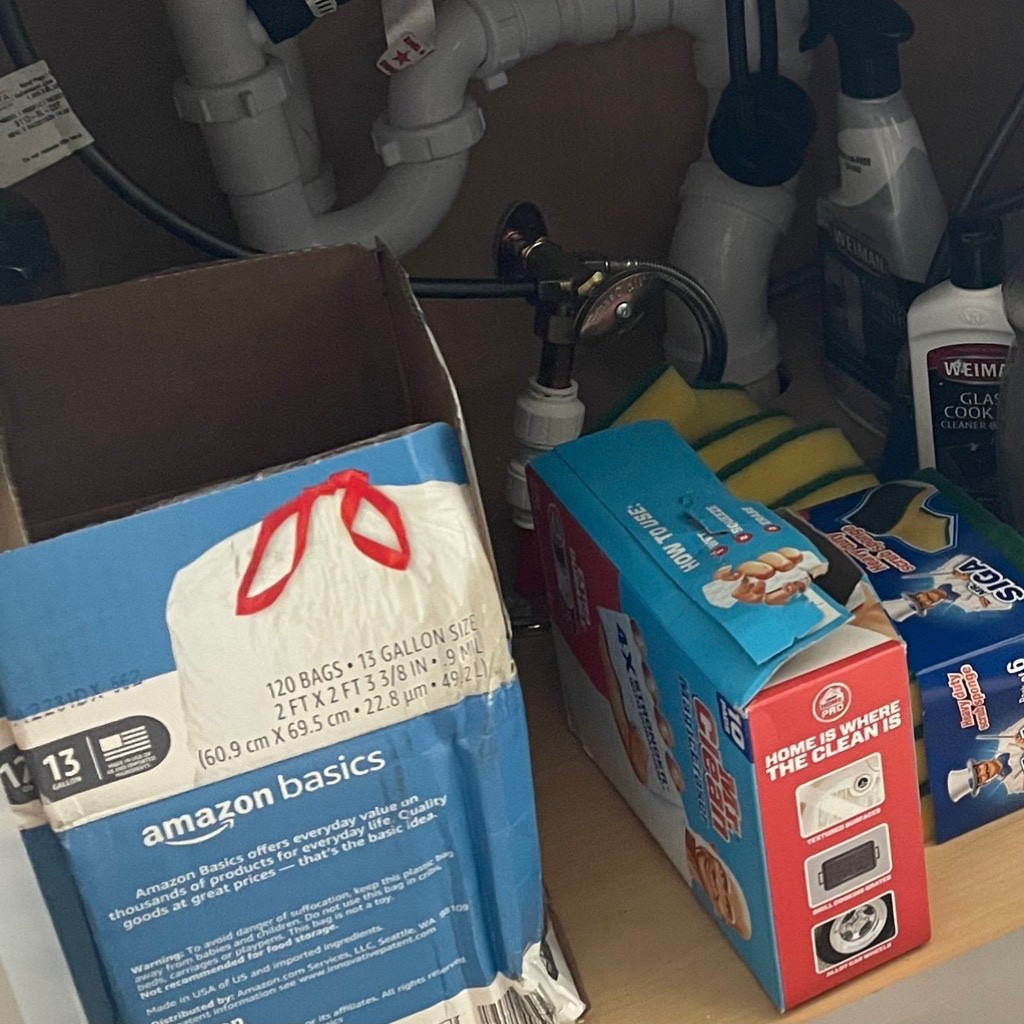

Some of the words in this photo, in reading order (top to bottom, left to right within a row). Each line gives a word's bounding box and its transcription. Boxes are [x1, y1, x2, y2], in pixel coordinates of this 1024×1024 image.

[944, 406, 993, 419] COOK
[627, 502, 659, 528] USE:
[649, 526, 673, 545] TO
[663, 542, 700, 573] HOW
[266, 676, 296, 699] 120
[299, 660, 344, 690] BAGS
[357, 651, 377, 670] 13
[380, 628, 446, 663] GALLON
[448, 614, 479, 642] SIZE
[617, 623, 637, 678] 4X
[274, 703, 289, 721] 2
[289, 694, 310, 717] FT
[313, 689, 326, 709] X
[326, 686, 340, 704] 2
[341, 679, 364, 701] FT
[366, 676, 377, 692] 3
[380, 663, 408, 687] 3/8
[410, 657, 429, 676] IN
[821, 703, 844, 718] PRO
[947, 673, 967, 700] duty
[957, 700, 975, 729] Heavy
[960, 664, 985, 706] sponge
[197, 740, 241, 770] (60.9
[245, 734, 271, 754] cm
[271, 726, 286, 745] X
[286, 714, 324, 740] 69.5
[326, 707, 351, 728] cm
[364, 690, 401, 716] 22.8
[765, 736, 817, 768] HOME
[819, 728, 836, 741] IS
[840, 700, 901, 736] WHERE
[765, 753, 808, 781] THE
[811, 725, 878, 763] CLEAN
[883, 713, 901, 733] IS
[42, 747, 81, 781] 13
[694, 696, 731, 843] Clean
[140, 786, 275, 847] amazon
[278, 749, 386, 800] basics
[108, 887, 188, 921] thousands
[190, 878, 206, 892] of
[209, 857, 275, 889] products
[277, 848, 297, 862] for
[301, 826, 365, 854] everyday
[398, 795, 447, 820] Quality
[135, 870, 196, 899] Amazon
[199, 853, 245, 876] Basics
[247, 838, 290, 860] offers
[293, 816, 357, 844] everyday
[360, 802, 397, 821] value
[401, 795, 419, 807] on
[123, 906, 169, 931] goods
[172, 899, 188, 912] at
[190, 884, 231, 907] great
[232, 867, 277, 892] prices
[341, 838, 366, 852] the
[367, 826, 403, 844] basic
[130, 951, 185, 974] Warning:
[185, 945, 201, 954] To
[203, 931, 233, 949] avoid
[235, 919, 274, 938] danger
[275, 912, 288, 923] of
[140, 986, 163, 1000] Not
[164, 955, 245, 991] recommended
[246, 949, 264, 961] for
[266, 938, 292, 954] food
